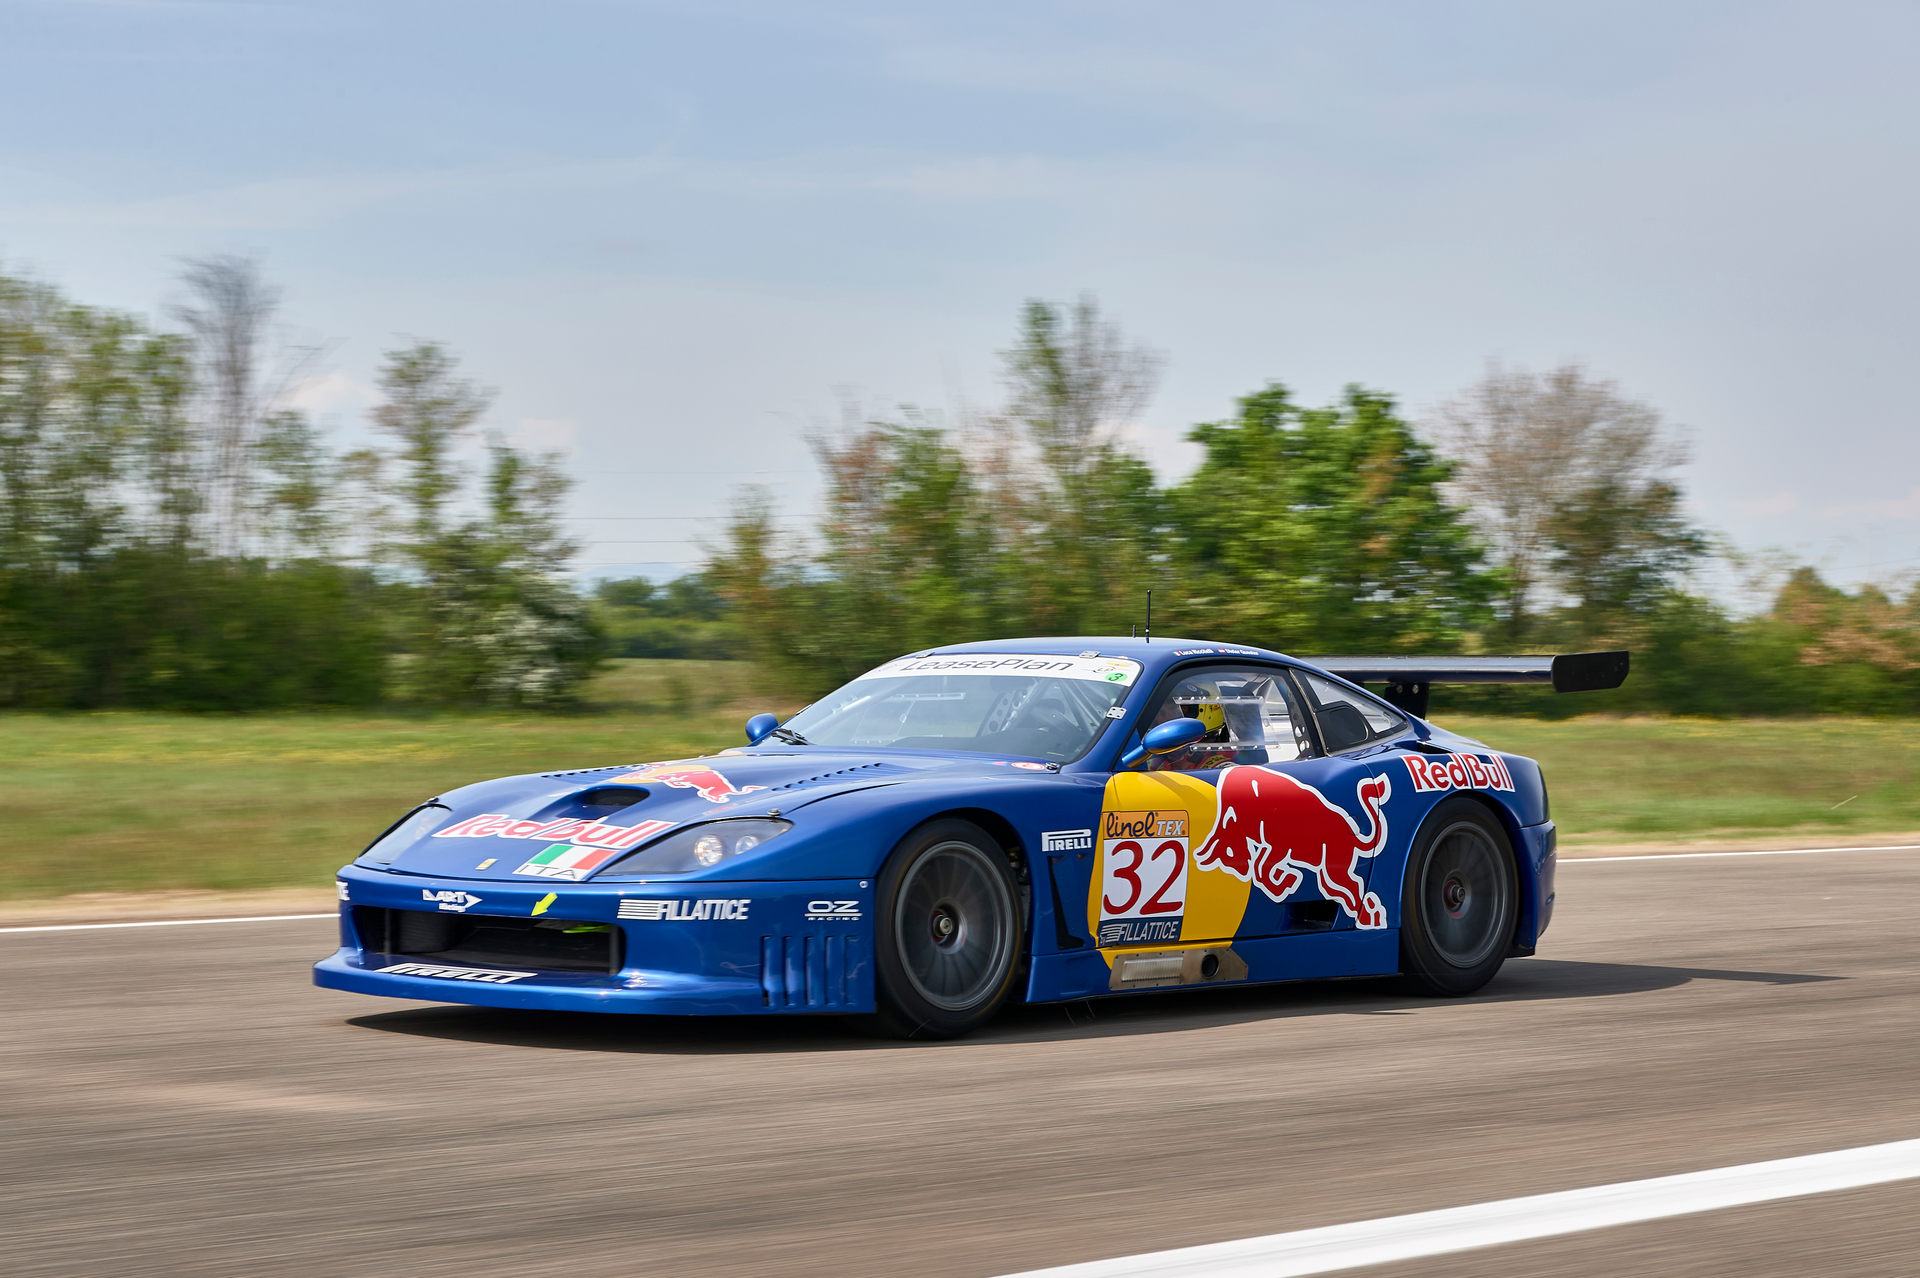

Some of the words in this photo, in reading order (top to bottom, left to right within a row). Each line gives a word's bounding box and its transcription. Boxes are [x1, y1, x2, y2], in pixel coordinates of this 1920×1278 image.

[900, 658, 1074, 672] LeasePlan
[1108, 672, 1124, 682] 3
[1403, 753, 1469, 790] Red
[1460, 753, 1514, 790] Bull
[438, 815, 578, 838] Red
[1156, 820, 1184, 836] TEX
[1041, 829, 1092, 852] PIRELLI
[517, 864, 578, 880] ITA
[1103, 840, 1185, 915] 32
[657, 899, 751, 921] FILLATTICE
[807, 900, 860, 913] OZ
[1118, 921, 1178, 941] FILLATTICE
[373, 963, 538, 983] PIRELLI
